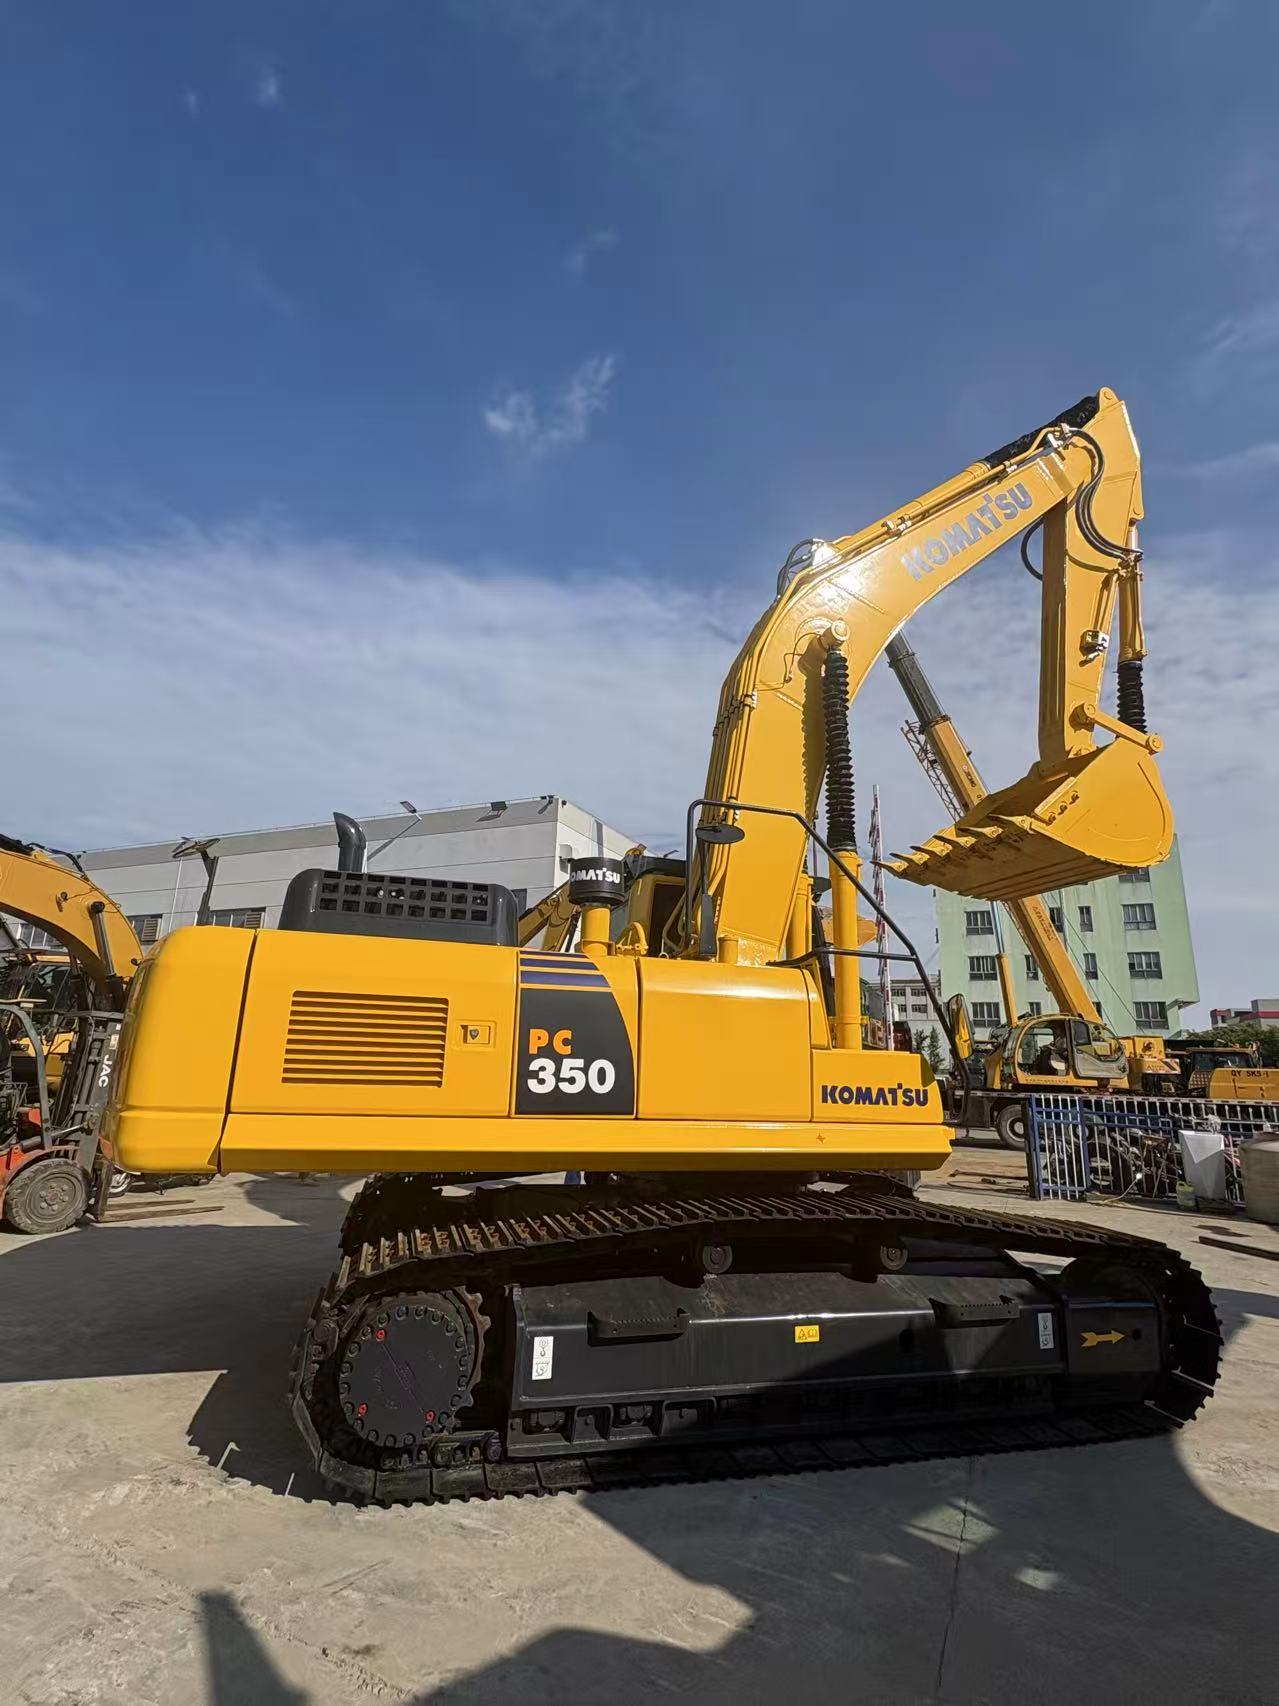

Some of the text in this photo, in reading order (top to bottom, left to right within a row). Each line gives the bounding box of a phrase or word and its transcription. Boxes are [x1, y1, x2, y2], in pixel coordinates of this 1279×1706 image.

[901, 482, 1033, 581] KOMATSU
[570, 867, 621, 884] OMATSU
[528, 1028, 572, 1055] PC
[98, 1054, 113, 1088] JAC
[527, 1058, 616, 1094] 350
[821, 1083, 928, 1106] KOMATSU
